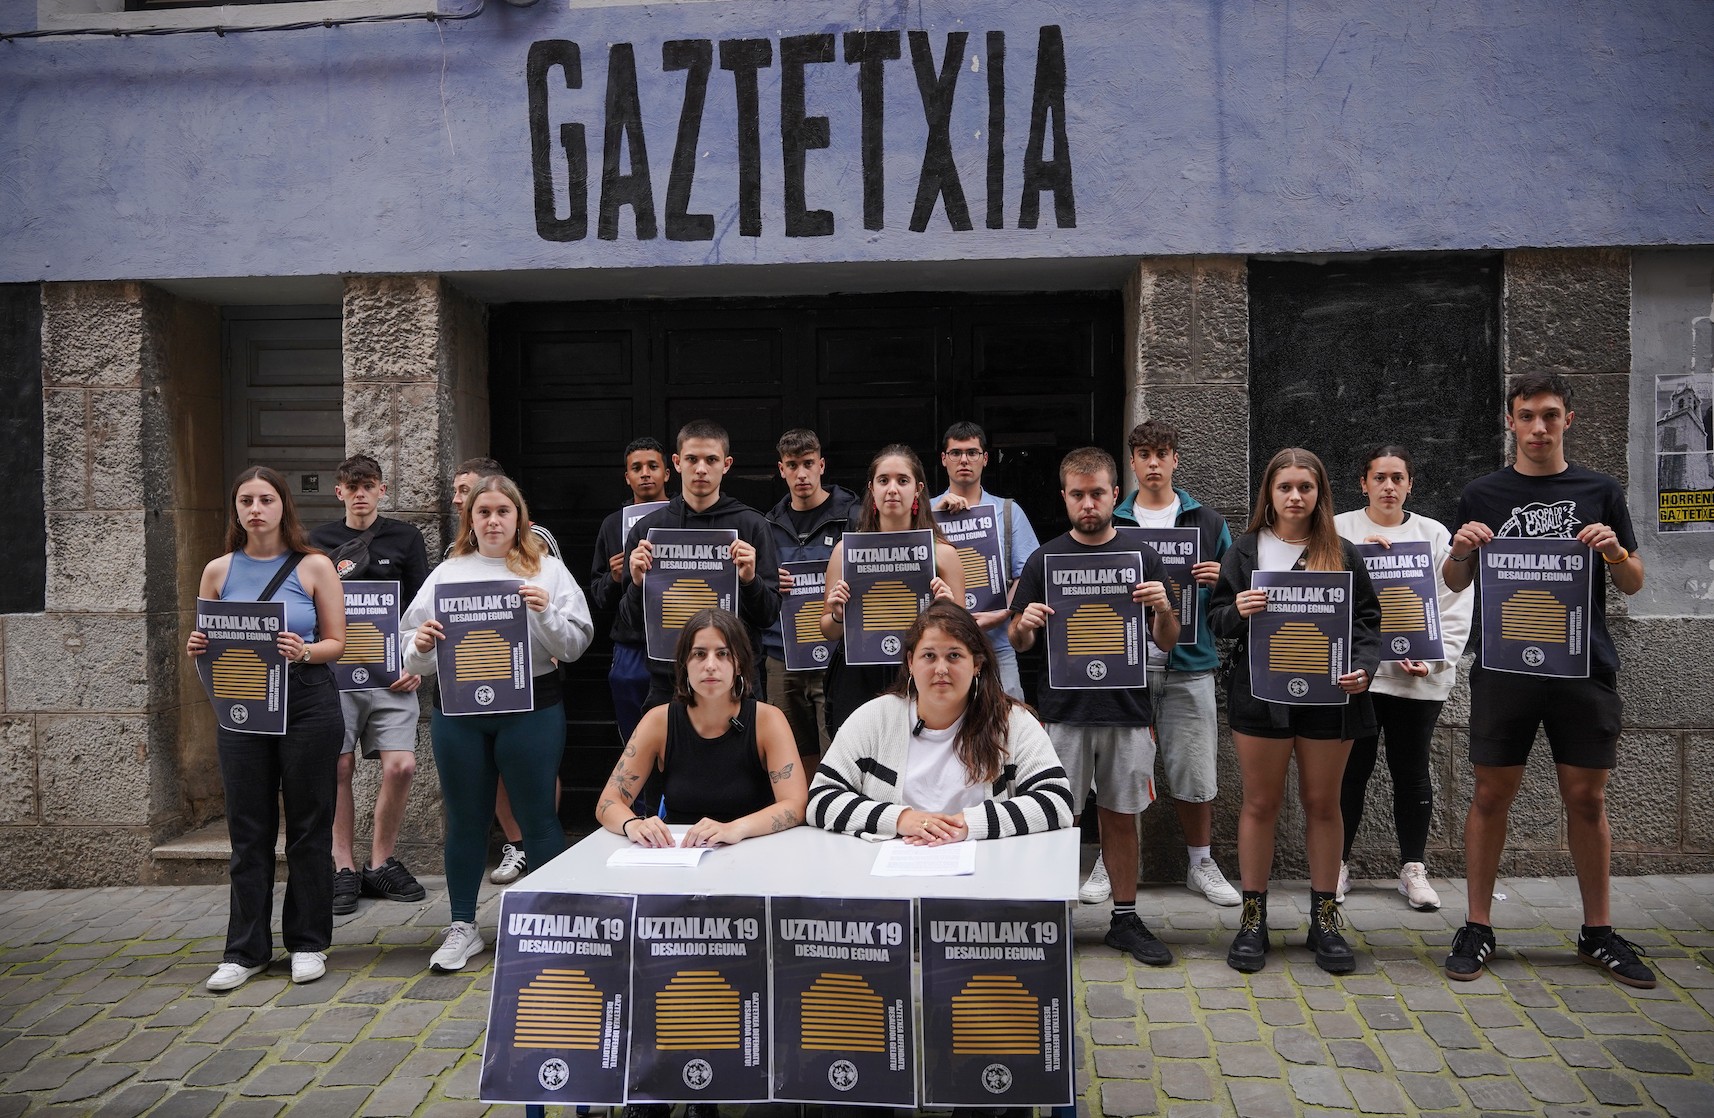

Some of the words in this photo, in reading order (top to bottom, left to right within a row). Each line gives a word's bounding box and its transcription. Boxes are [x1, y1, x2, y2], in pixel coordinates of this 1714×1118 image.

[526, 24, 1078, 242] GAZTETXIA
[1661, 493, 1714, 505] HORREN
[937, 518, 977, 534] TAILAK
[978, 517, 992, 529] 19
[947, 534, 965, 542] ALOJO
[966, 530, 987, 539] EGUNA
[652, 545, 713, 559] UZTAILAK
[715, 545, 731, 559] 19
[848, 548, 910, 563] UZTAILAK
[911, 546, 928, 560] 19
[1178, 542, 1193, 555] 19
[660, 561, 697, 569] DESALOJO
[698, 562, 723, 570] EGUNA
[1162, 556, 1185, 564] EGUNA
[1362, 555, 1414, 570] ZTAILAK
[1415, 554, 1429, 567] 19
[1487, 553, 1561, 570] UZTAILAK
[1563, 555, 1583, 571] 19
[857, 564, 893, 573] DESALOJO
[895, 563, 920, 572] EGUNA
[1402, 570, 1423, 578] EGUNA
[1052, 569, 1117, 585] UZTAILAK
[1119, 568, 1136, 583] 19
[1498, 571, 1541, 581] DESALOJO
[1542, 572, 1573, 581] EGUNA
[1062, 586, 1100, 595] DESALOJO
[1101, 585, 1128, 594] EGUNA
[1328, 588, 1344, 602] 19
[380, 594, 394, 606] 19
[440, 596, 503, 613] UZTAILAK
[504, 594, 520, 609] 19
[367, 607, 387, 615] EGUNA
[1267, 604, 1306, 613] DESALOJO
[1307, 605, 1335, 613] EGUNA
[199, 614, 260, 631] UZTAILAK
[262, 617, 279, 631] 19
[450, 612, 486, 622] DESALOJO
[488, 611, 513, 621] EGUNA
[208, 631, 244, 641] DESALOJO
[246, 632, 272, 641] EGUNA
[508, 913, 600, 939] UZTAILAK
[601, 918, 624, 941] 19
[638, 916, 732, 940] UZTAILAK
[733, 918, 758, 940] 19
[780, 919, 875, 944] UZTAILAK
[876, 922, 902, 946] 19
[930, 920, 1031, 944] UZTAILAK
[1031, 922, 1058, 944] 19
[518, 939, 574, 955] DESALOJO
[576, 942, 612, 956] EGUNA
[651, 943, 706, 956] DESALOJO
[709, 943, 746, 956] EGUNA
[795, 944, 849, 959] DESALOJO
[850, 947, 889, 962] EGUNA
[945, 947, 1003, 959] DESALOJO
[1005, 947, 1045, 960] EGUNA
[613, 994, 621, 1029] GAZTETXEA
[895, 999, 903, 1033] GAZTETXEA
[605, 1001, 613, 1038] DESALOJOA
[602, 1039, 611, 1068] GELDITU!
